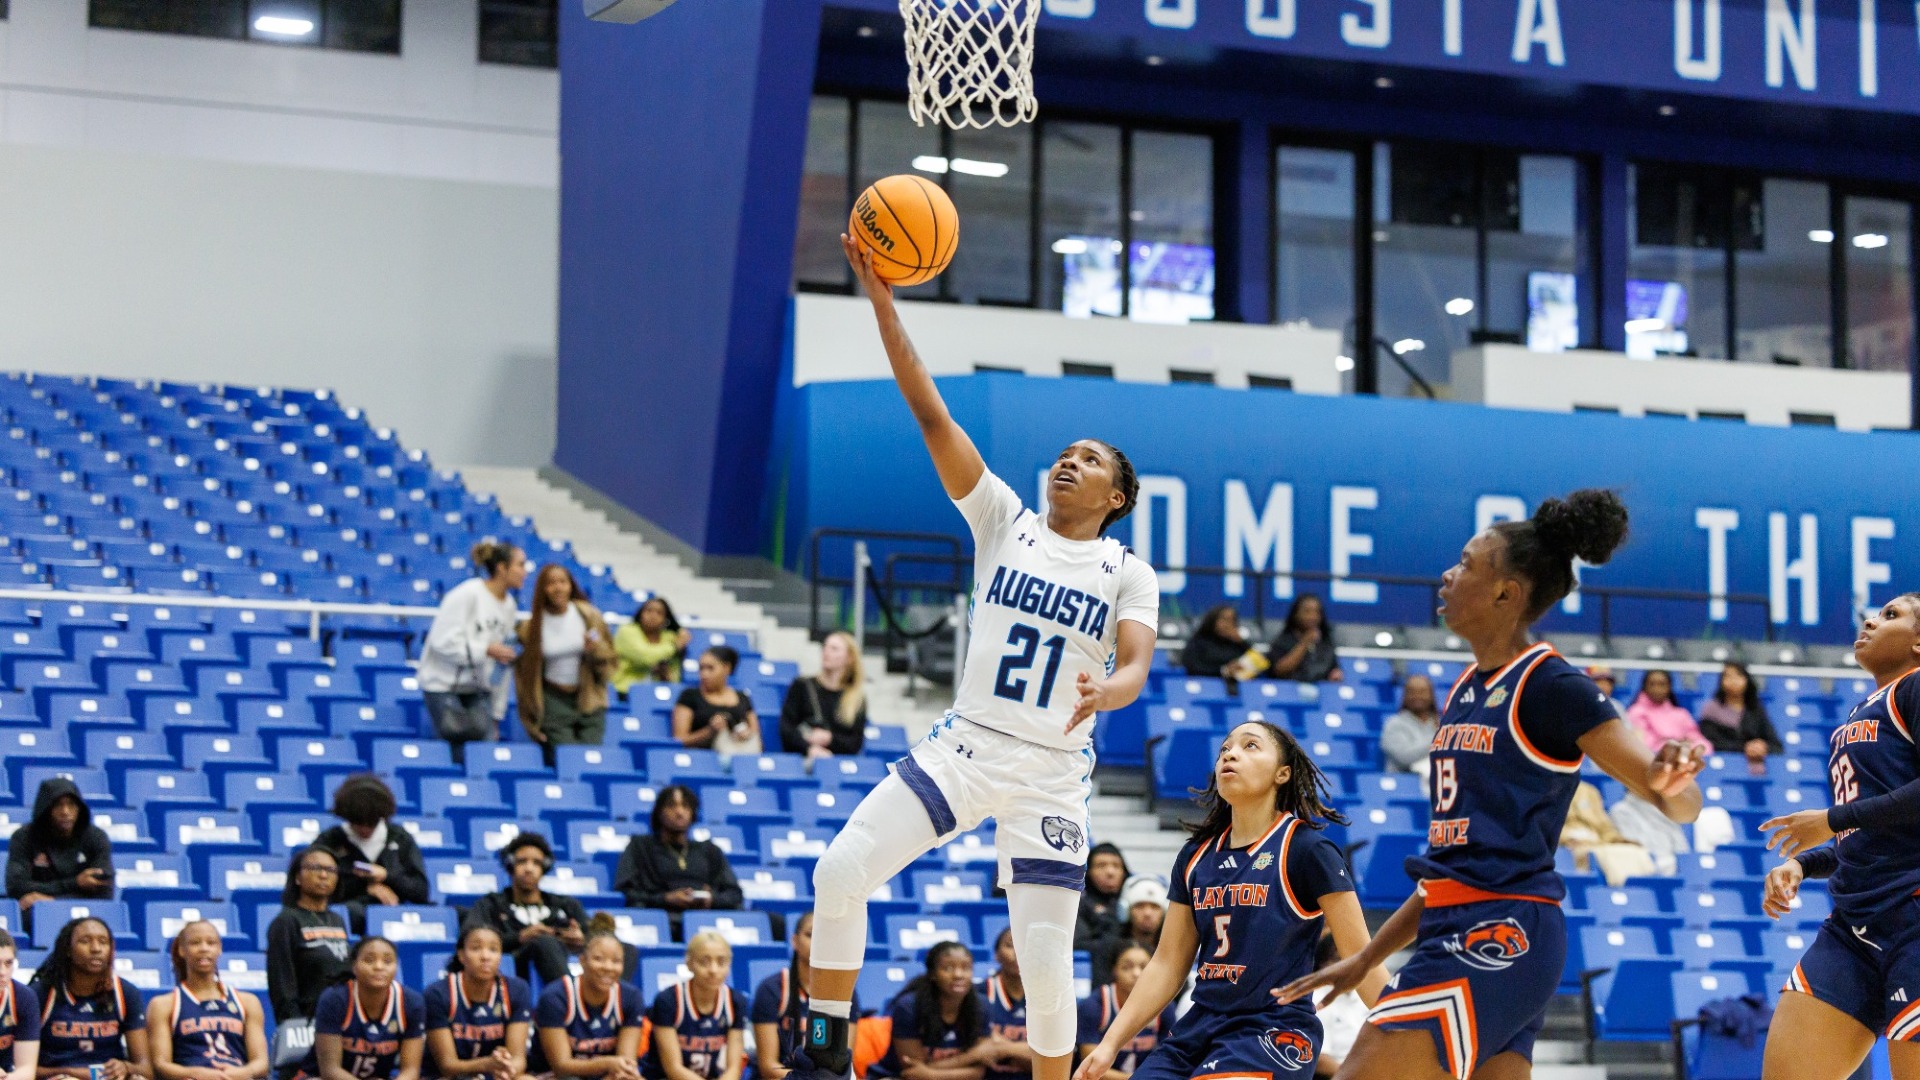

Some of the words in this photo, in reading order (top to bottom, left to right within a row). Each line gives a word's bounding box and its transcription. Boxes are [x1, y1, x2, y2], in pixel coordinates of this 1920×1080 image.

[1674, 0, 1920, 97] UNI
[1038, 469, 1379, 603] OME
[1695, 507, 1895, 628] THE
[986, 565, 1110, 642] AUGUSTA
[994, 622, 1067, 709] 21
[1429, 723, 1498, 754] AYTON
[1435, 758, 1458, 812] 13
[1831, 753, 1860, 806] 22
[1428, 817, 1470, 847] TATE
[1213, 914, 1232, 958] 5
